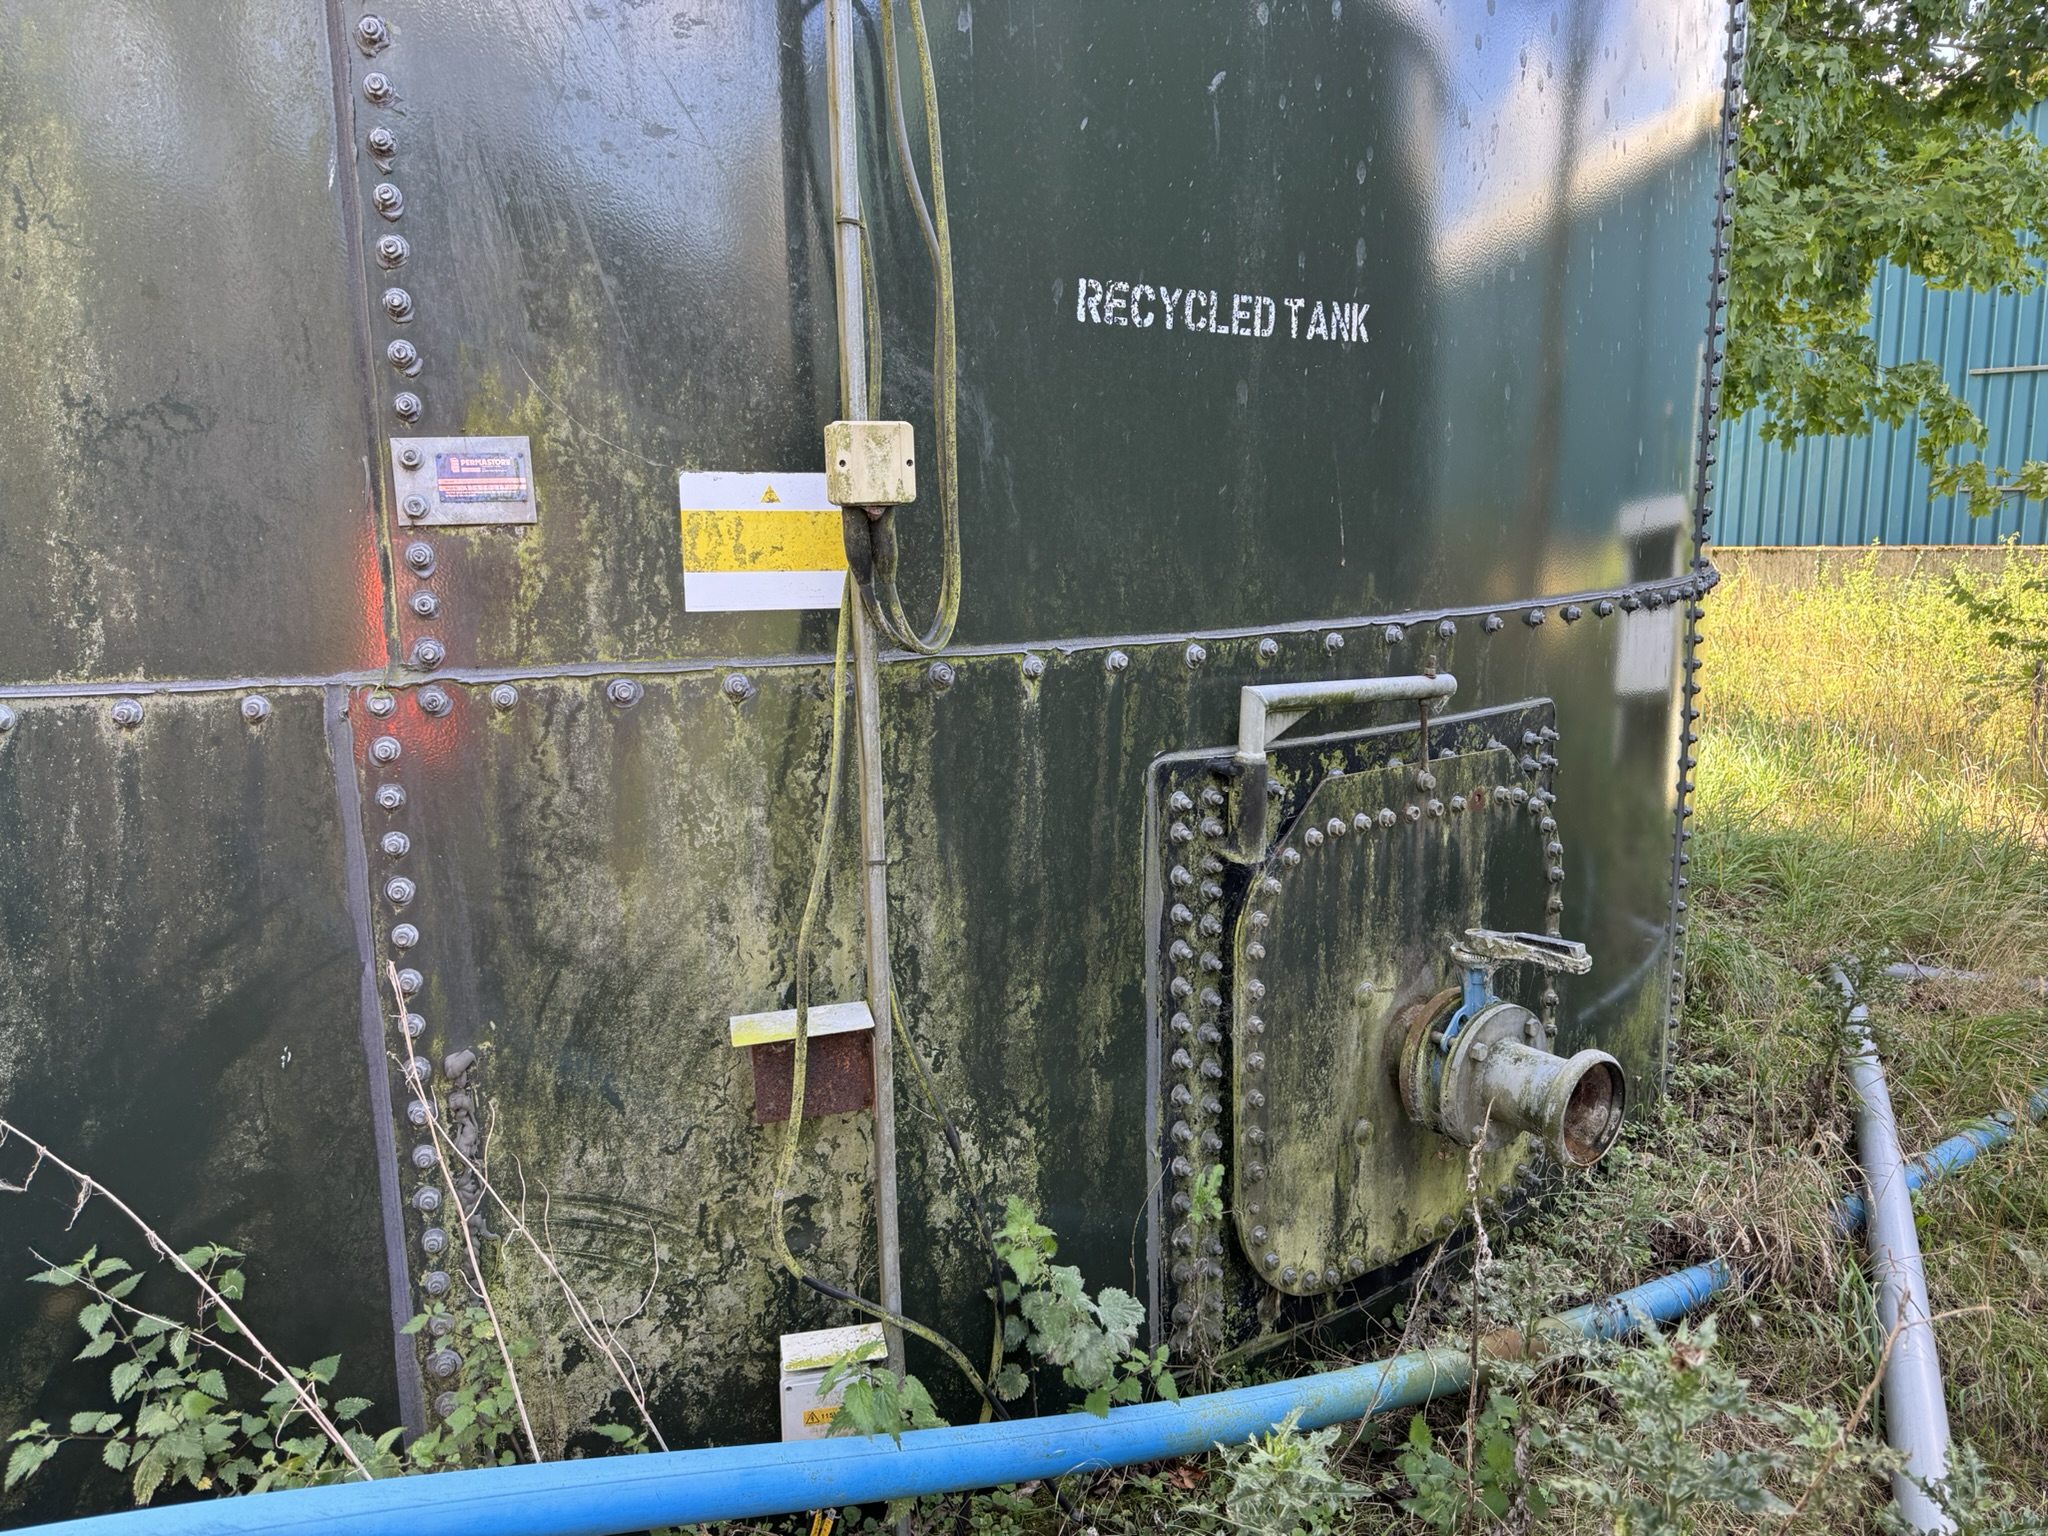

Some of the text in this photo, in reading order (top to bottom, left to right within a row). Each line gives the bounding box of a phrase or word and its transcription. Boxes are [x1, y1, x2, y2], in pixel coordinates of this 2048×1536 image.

[1077, 277, 1370, 343] RECYCLED TANK
[460, 458, 511, 466] PERMASTORE
